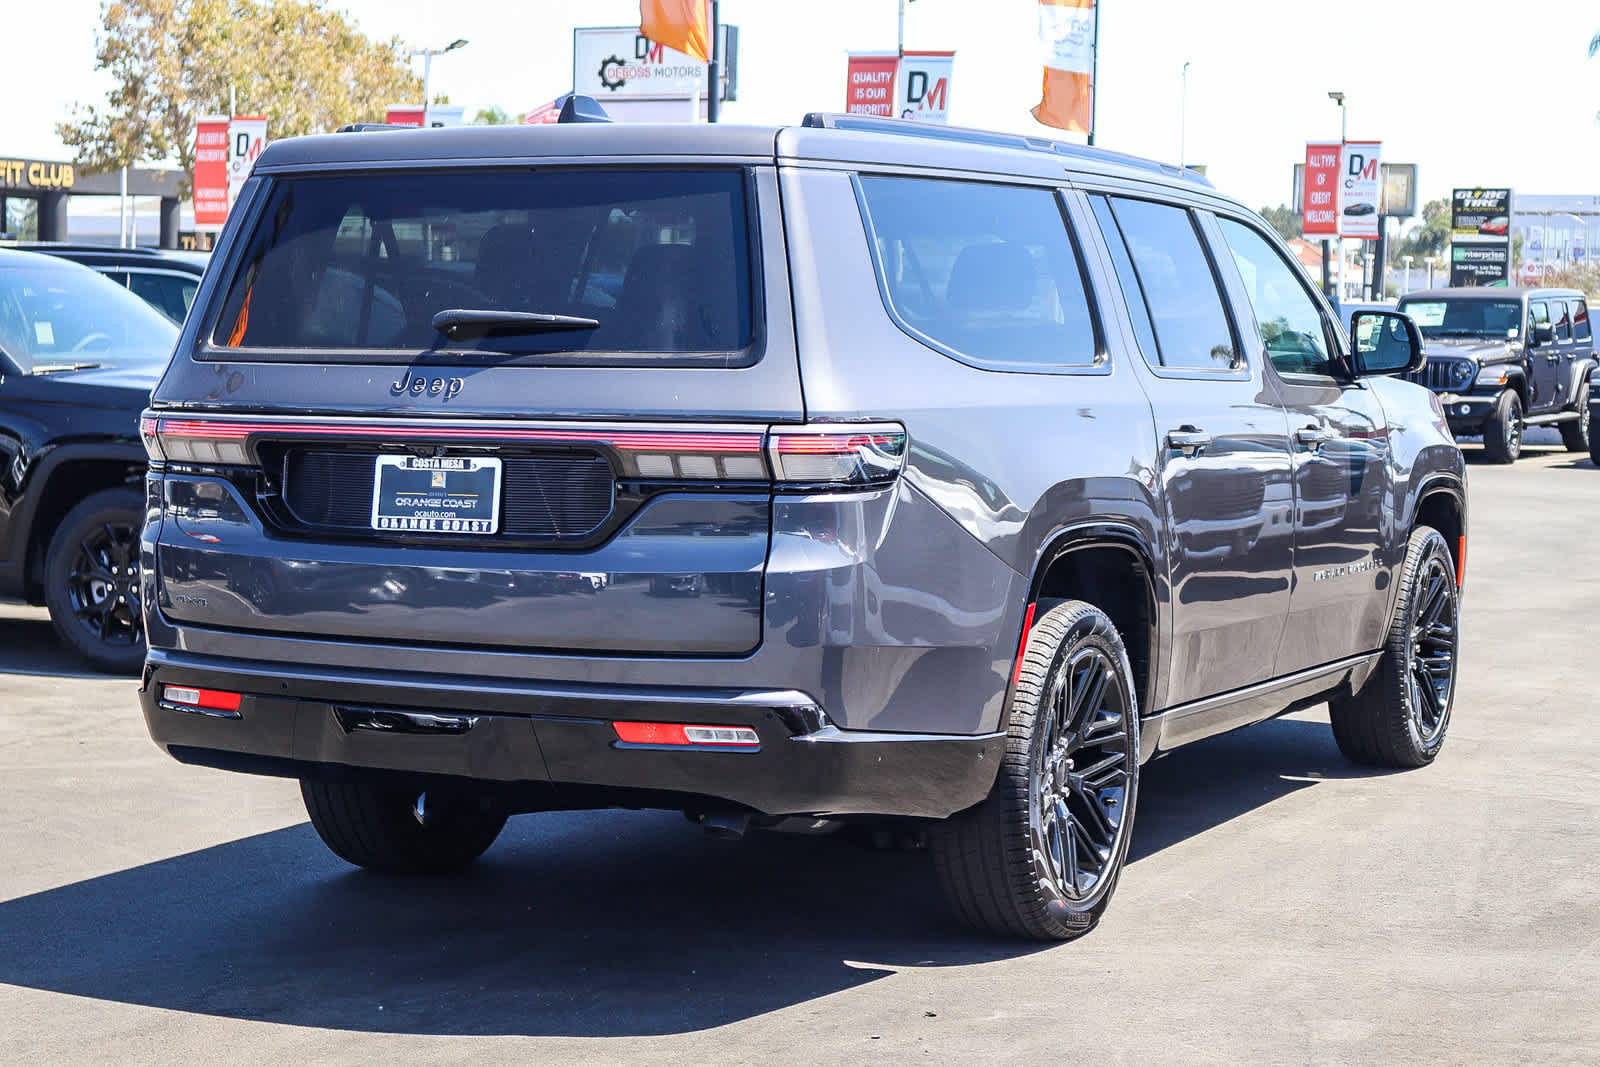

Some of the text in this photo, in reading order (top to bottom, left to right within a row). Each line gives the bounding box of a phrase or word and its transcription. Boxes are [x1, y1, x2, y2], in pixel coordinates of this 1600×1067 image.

[654, 66, 702, 79] MOTORS
[853, 72, 892, 83] QUALITY
[856, 88, 887, 99] IS OUR
[850, 103, 891, 116] PRIORITY
[1310, 155, 1336, 167] ALL TYPE
[28, 162, 74, 188] CLUB
[1316, 174, 1326, 185] OF
[1311, 192, 1332, 204] CREDIT
[1306, 210, 1335, 224] WELCOME
[391, 370, 465, 399] Jeep
[412, 458, 464, 470] COSTA MESA
[395, 497, 478, 509] ORANGE COAST
[414, 510, 456, 519] ocauto.com
[380, 517, 489, 532] ORANGE COAST
